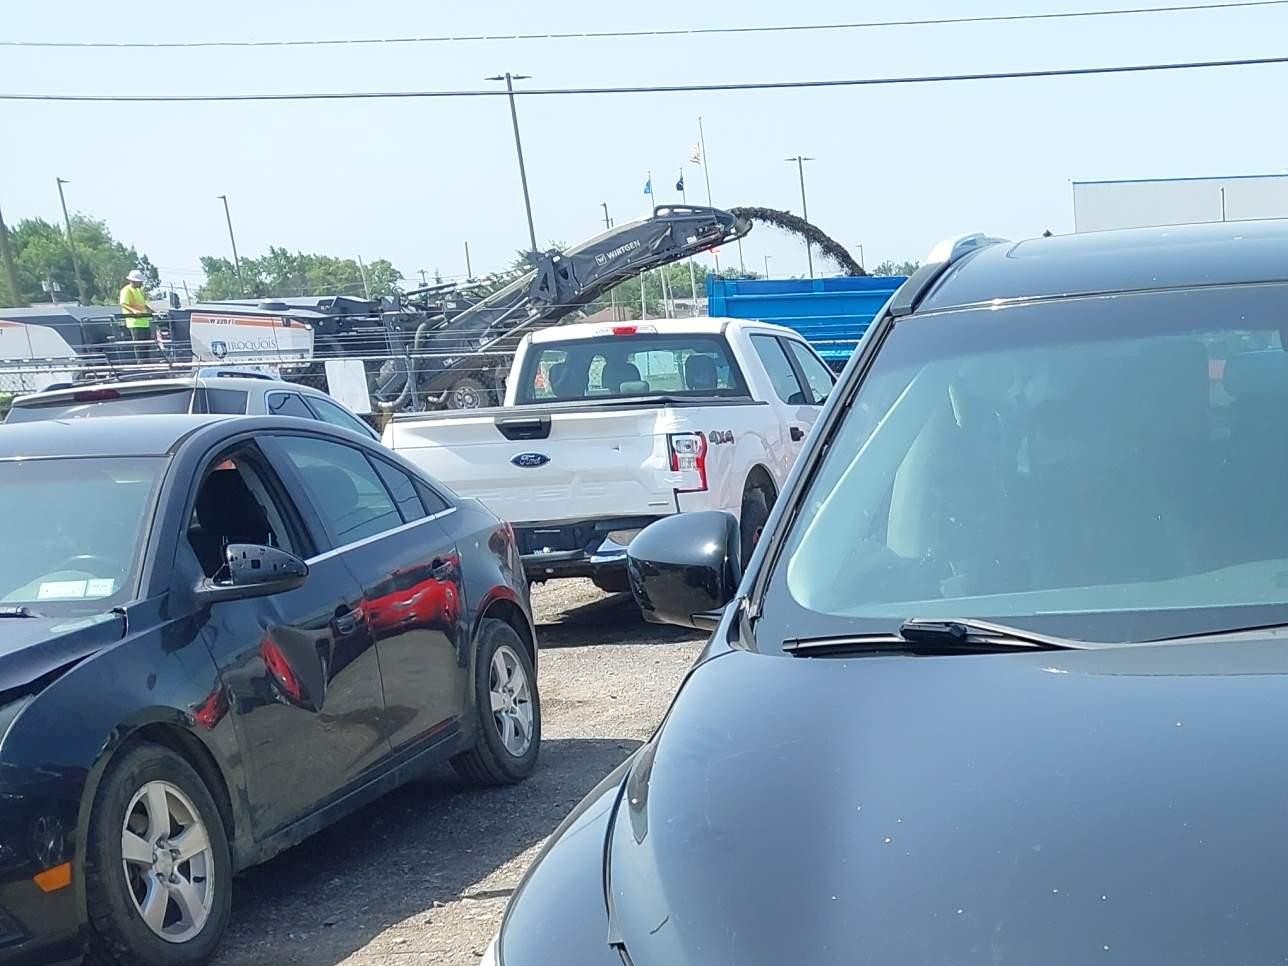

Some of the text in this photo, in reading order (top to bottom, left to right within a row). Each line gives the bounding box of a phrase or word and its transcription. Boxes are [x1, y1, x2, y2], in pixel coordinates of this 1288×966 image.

[606, 240, 641, 260] WIRTGEN
[227, 339, 277, 351] IROQUOIS
[520, 454, 541, 465] Ford
